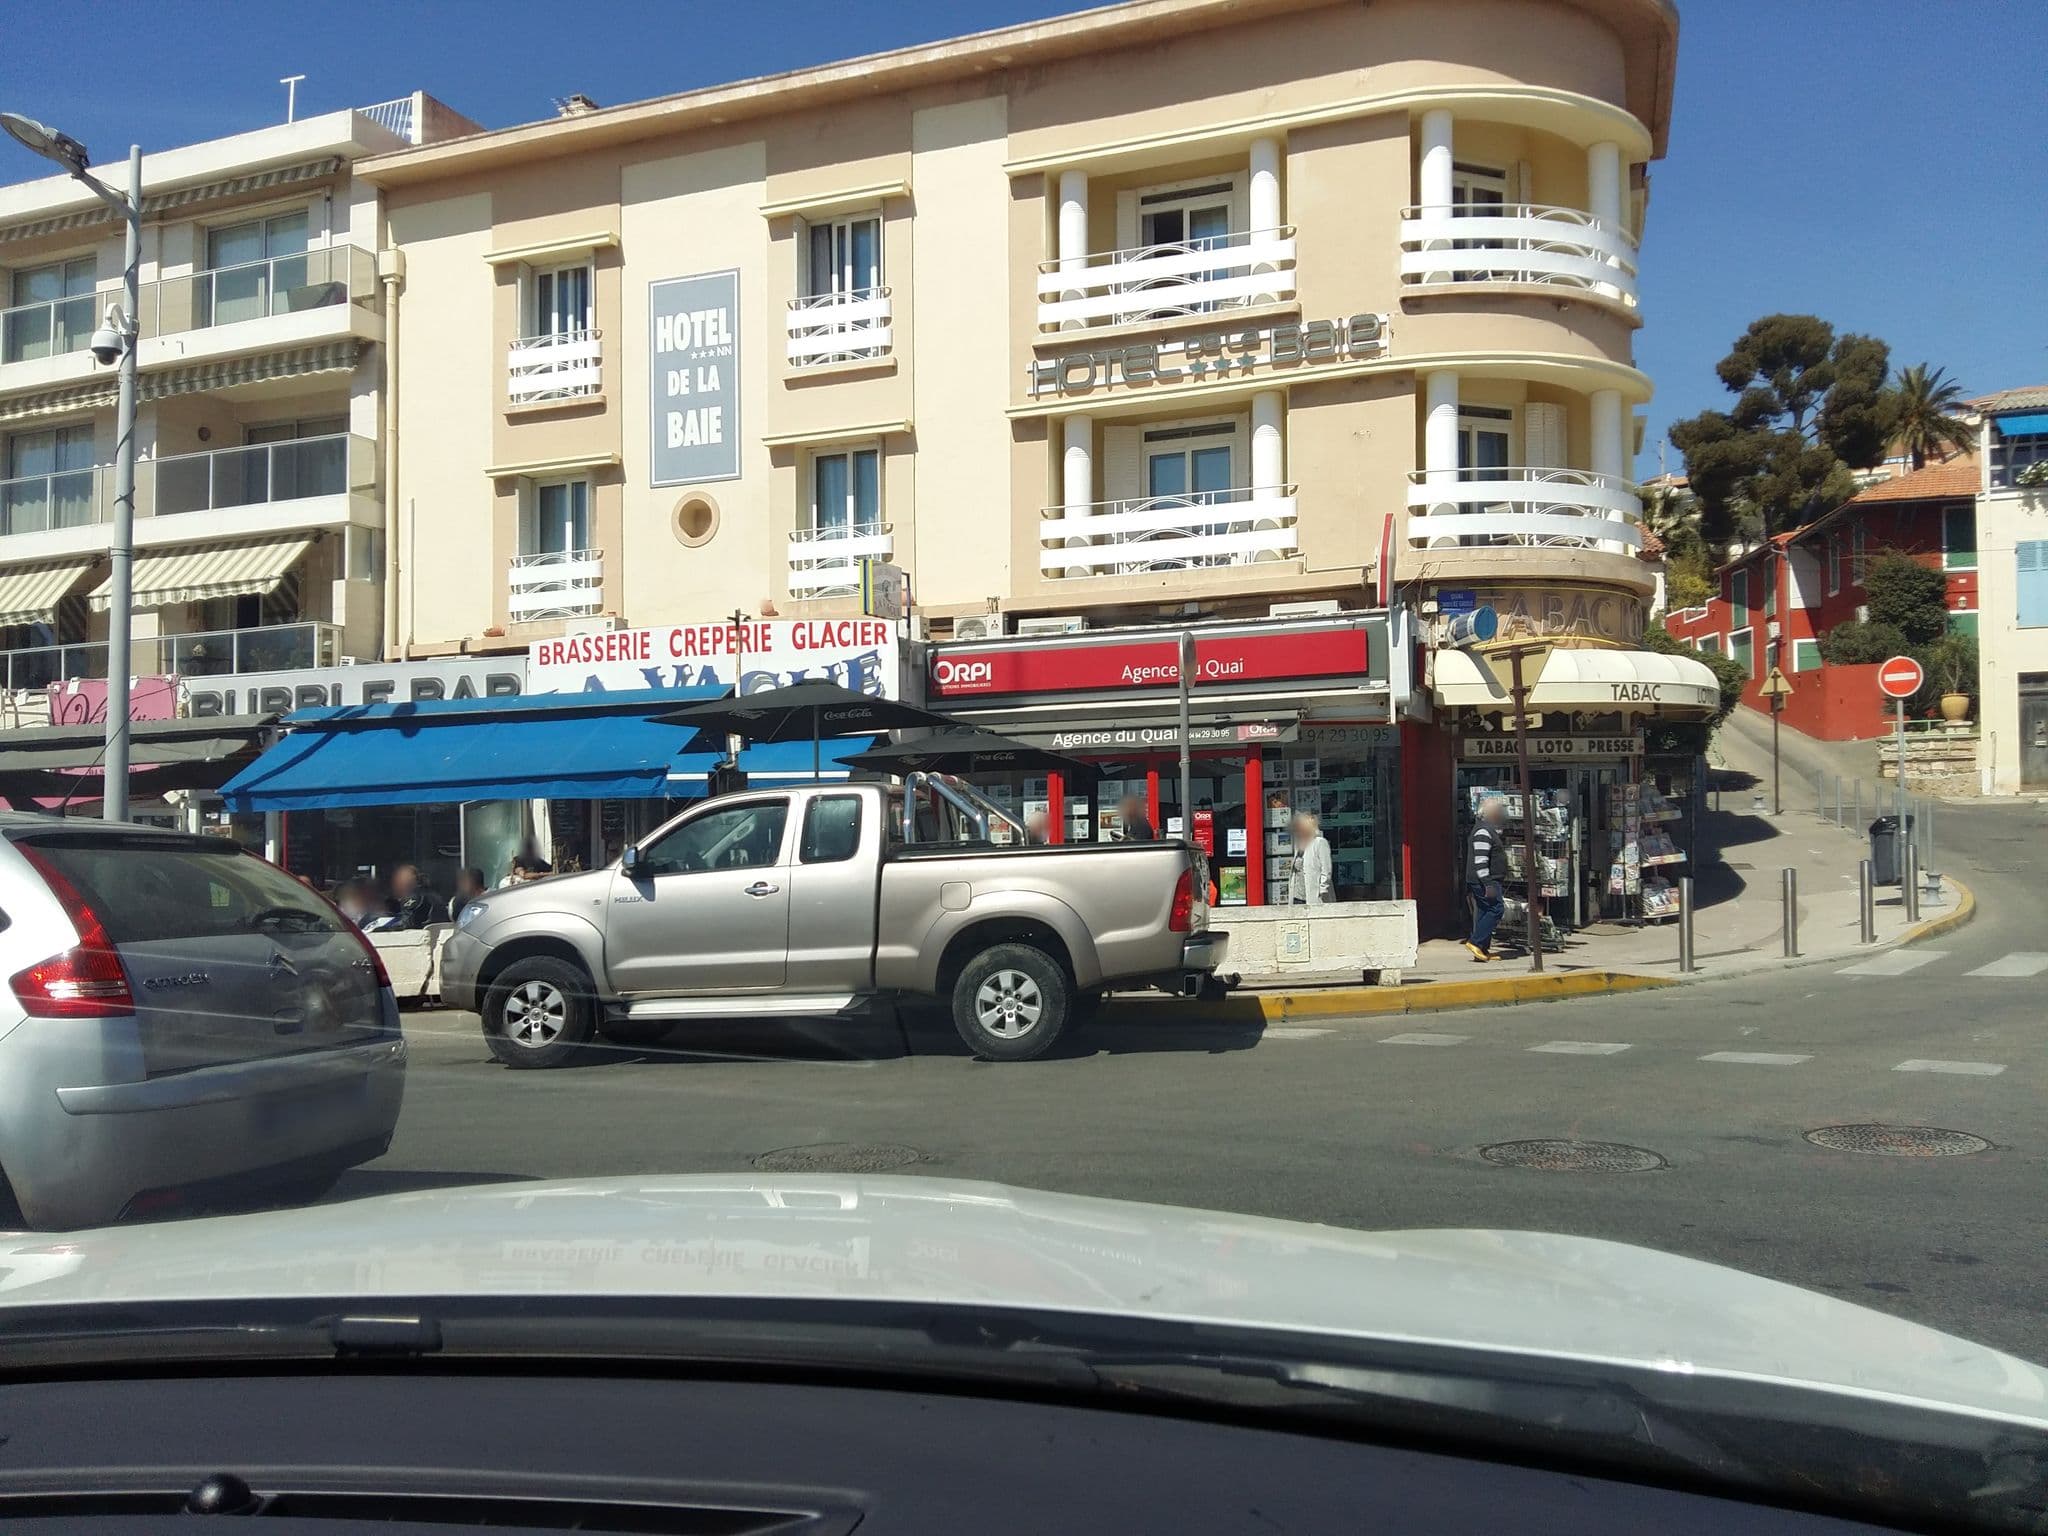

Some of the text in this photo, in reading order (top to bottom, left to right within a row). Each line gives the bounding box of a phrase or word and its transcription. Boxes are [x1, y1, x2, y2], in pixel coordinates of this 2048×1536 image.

[656, 307, 732, 353] HOTEL
[667, 364, 721, 397] DE LA
[1032, 344, 1183, 397] HOTEL
[667, 406, 722, 449] BAIE
[539, 621, 888, 666] BRASSERIE CREPERIE GLACIER
[933, 660, 992, 684] ORPI
[1121, 664, 1178, 684] Agence
[1205, 657, 1244, 678] Quai
[1610, 683, 1662, 702] TABAC
[1052, 727, 1178, 748] Agence du Quai
[1201, 730, 1211, 738] 29
[1211, 730, 1220, 738] 30
[1220, 729, 1230, 737] 95
[1307, 728, 1389, 742] 94 29 30 95
[1537, 740, 1573, 753] LOTO
[1588, 739, 1634, 753] PRESSE
